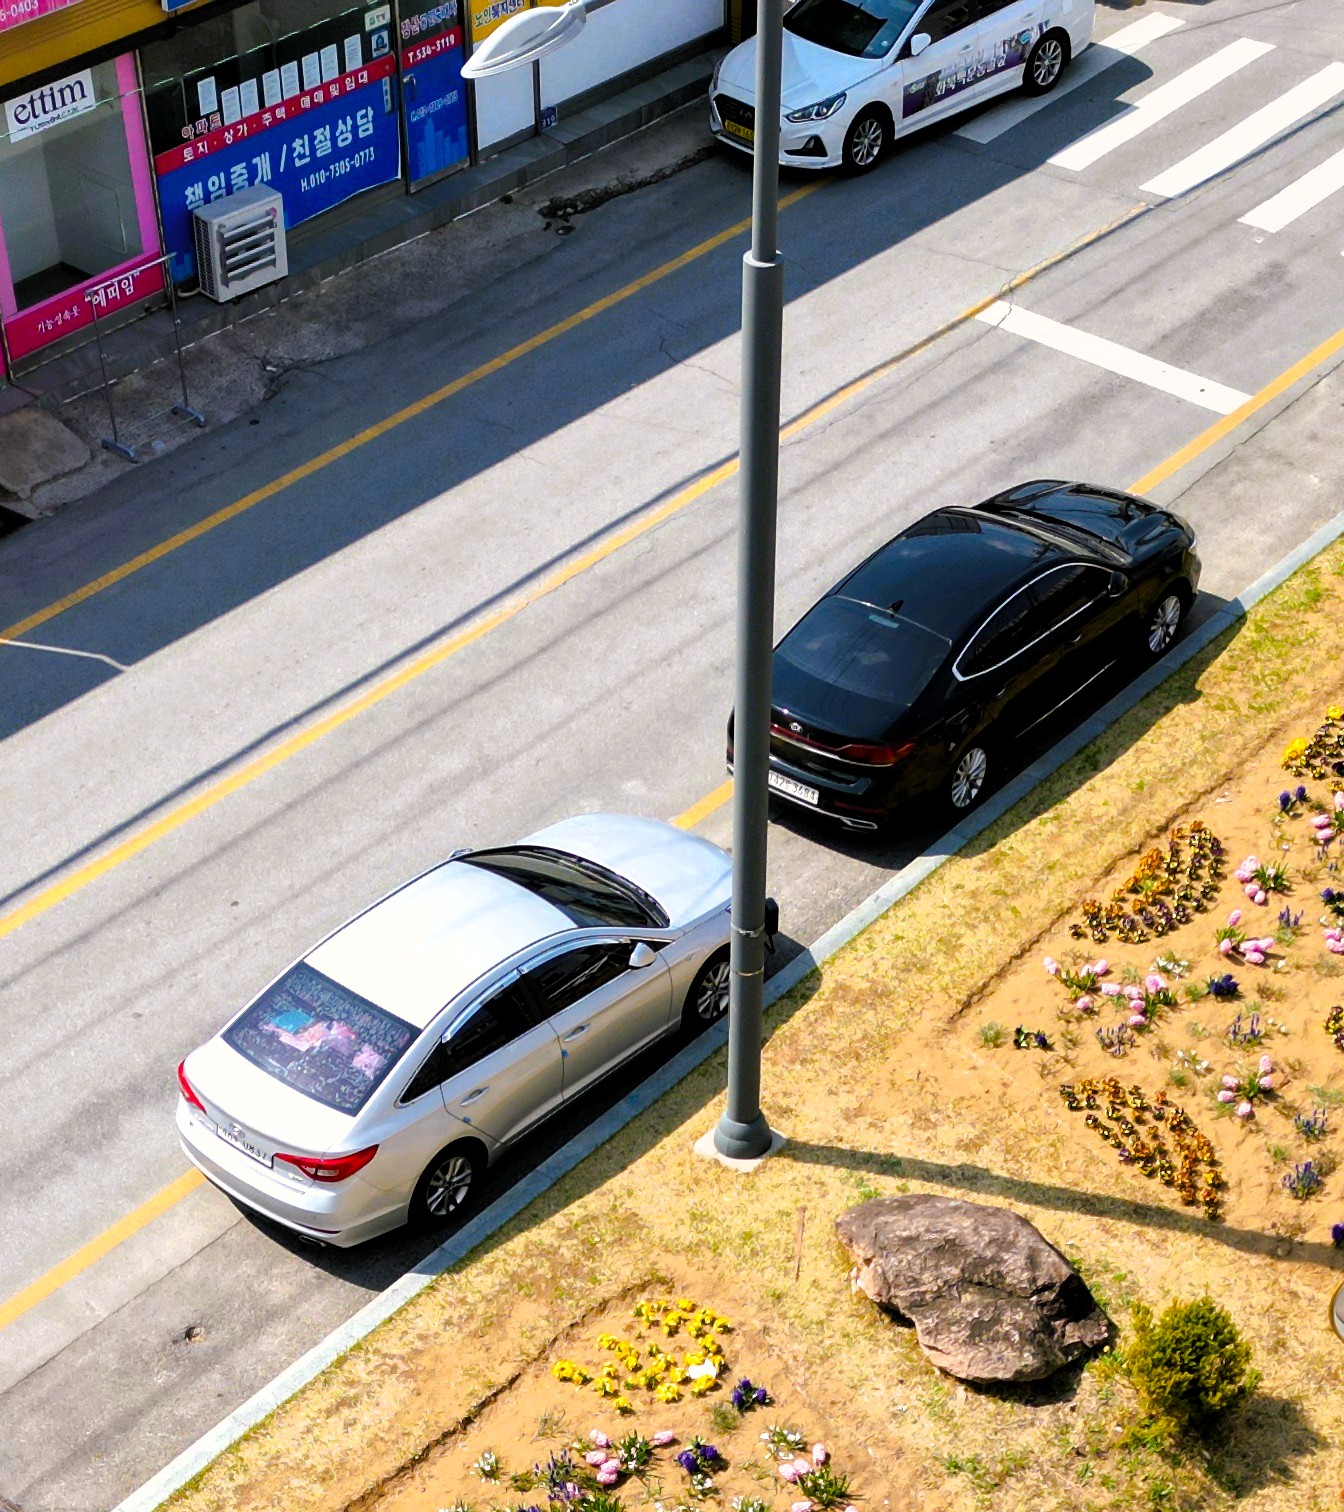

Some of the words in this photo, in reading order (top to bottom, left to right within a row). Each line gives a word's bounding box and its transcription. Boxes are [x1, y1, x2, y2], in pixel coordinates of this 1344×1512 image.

[14, 80, 87, 125] ettim
[183, 140, 208, 162] 토지
[223, 124, 248, 144] 상가
[262, 106, 286, 127] 주택
[344, 70, 368, 93] 임대
[181, 112, 222, 140] 아파트
[301, 146, 375, 192] H.010-7305-0773
